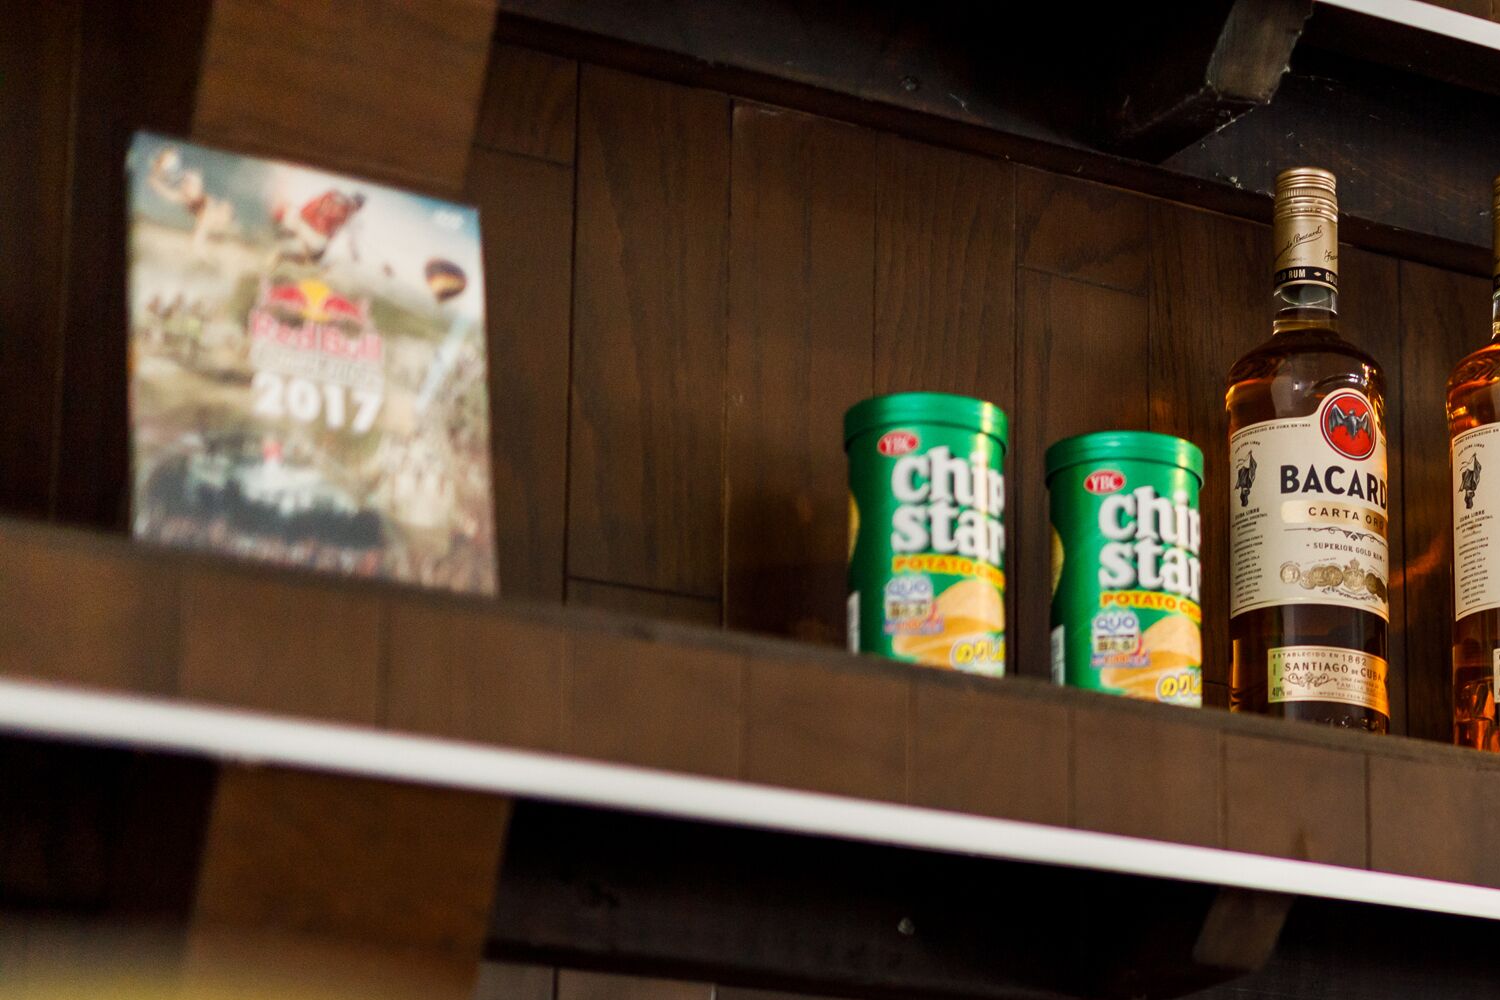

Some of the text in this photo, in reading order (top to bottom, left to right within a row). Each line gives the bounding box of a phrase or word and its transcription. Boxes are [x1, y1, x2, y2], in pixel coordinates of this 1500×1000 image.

[1288, 269, 1306, 279] RUM
[252, 370, 383, 436] 2017
[1088, 473, 1122, 492] YBC
[1280, 464, 1387, 510] BACARD
[1308, 506, 1385, 531] CARTA ORO
[1313, 542, 1353, 554] SUPERIOR
[1355, 546, 1373, 558] GOLD
[894, 557, 974, 577] POTATO
[1101, 593, 1177, 611] POTATO
[1096, 615, 1137, 634] QUO
[1341, 653, 1367, 667] 1862
[1284, 662, 1349, 674] SANTIAGO
[1360, 667, 1382, 682] CUBA
